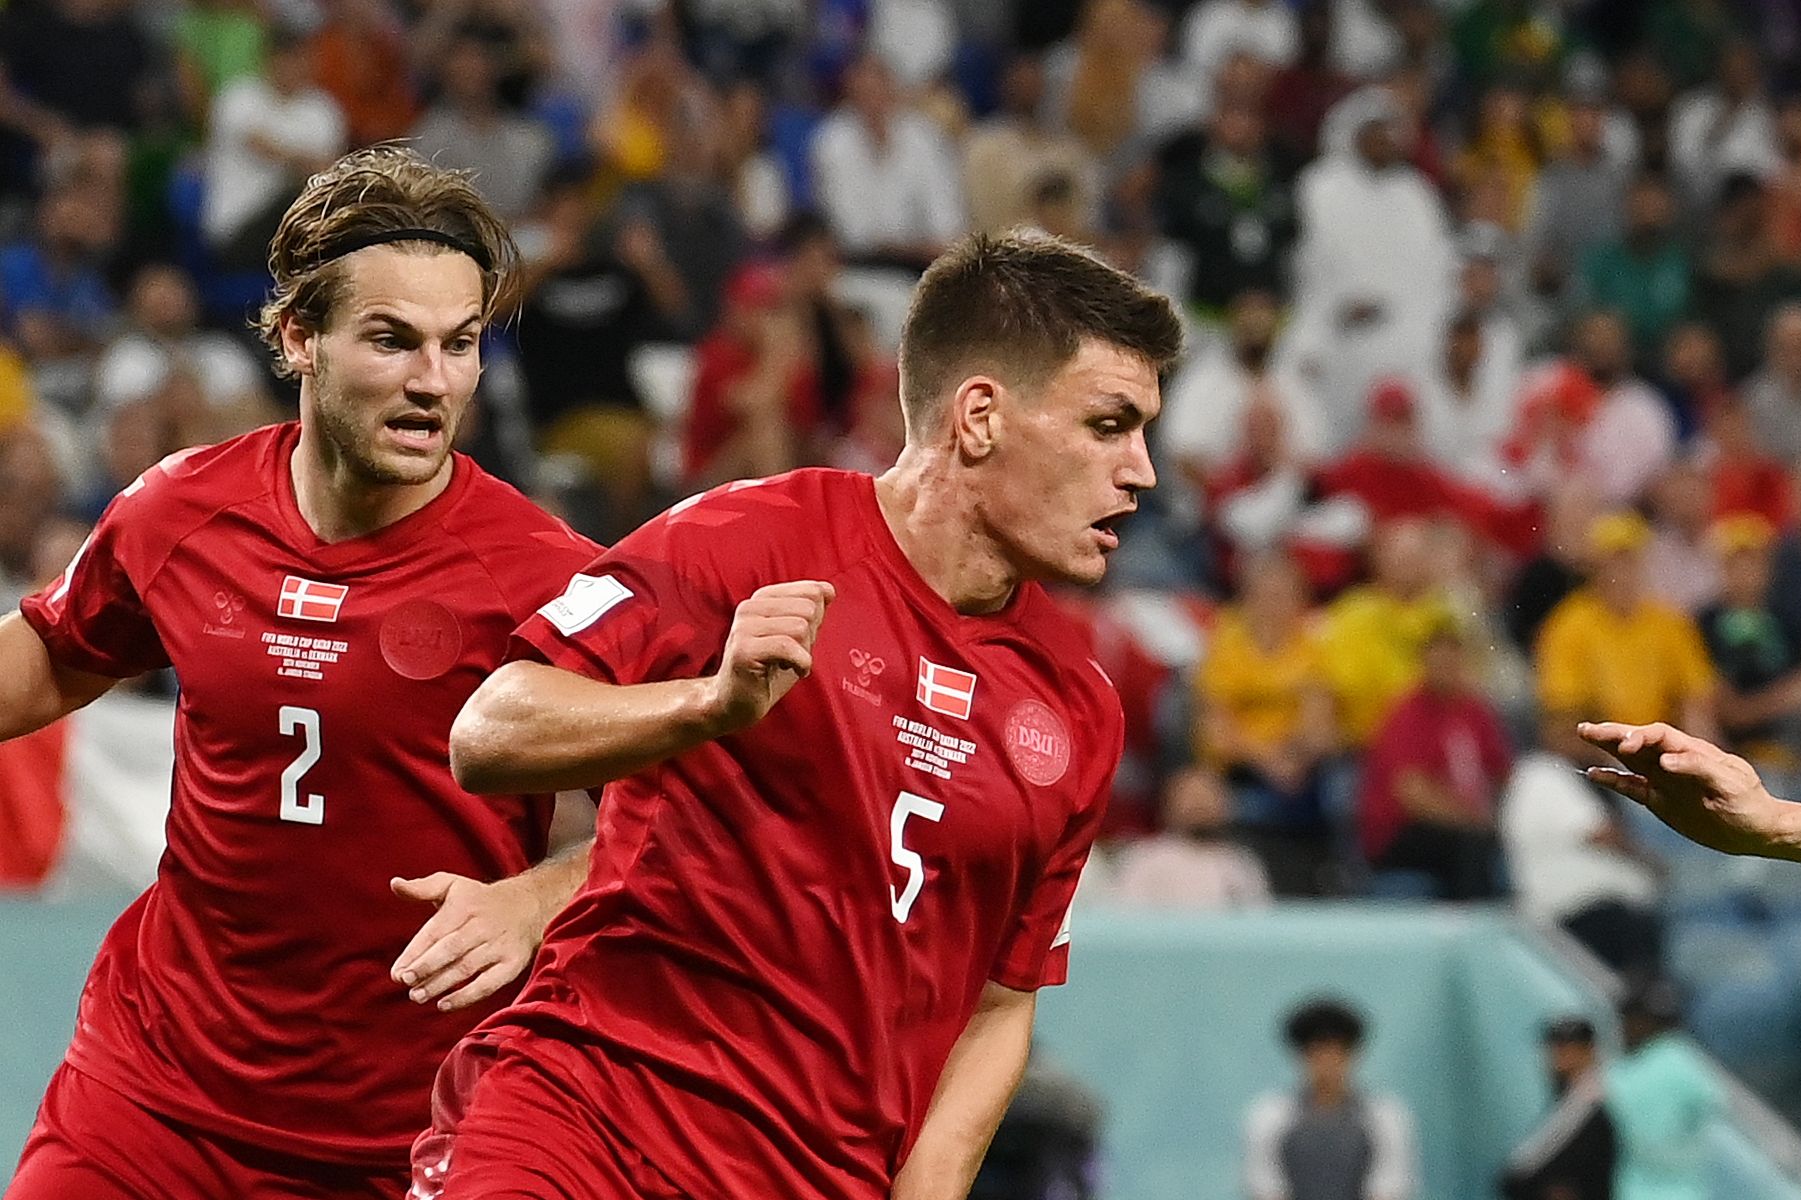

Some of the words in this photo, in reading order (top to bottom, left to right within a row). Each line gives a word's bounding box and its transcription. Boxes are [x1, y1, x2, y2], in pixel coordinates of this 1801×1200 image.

[279, 706, 325, 825] 2
[1018, 725, 1054, 756] DBU
[889, 790, 945, 924] 5
